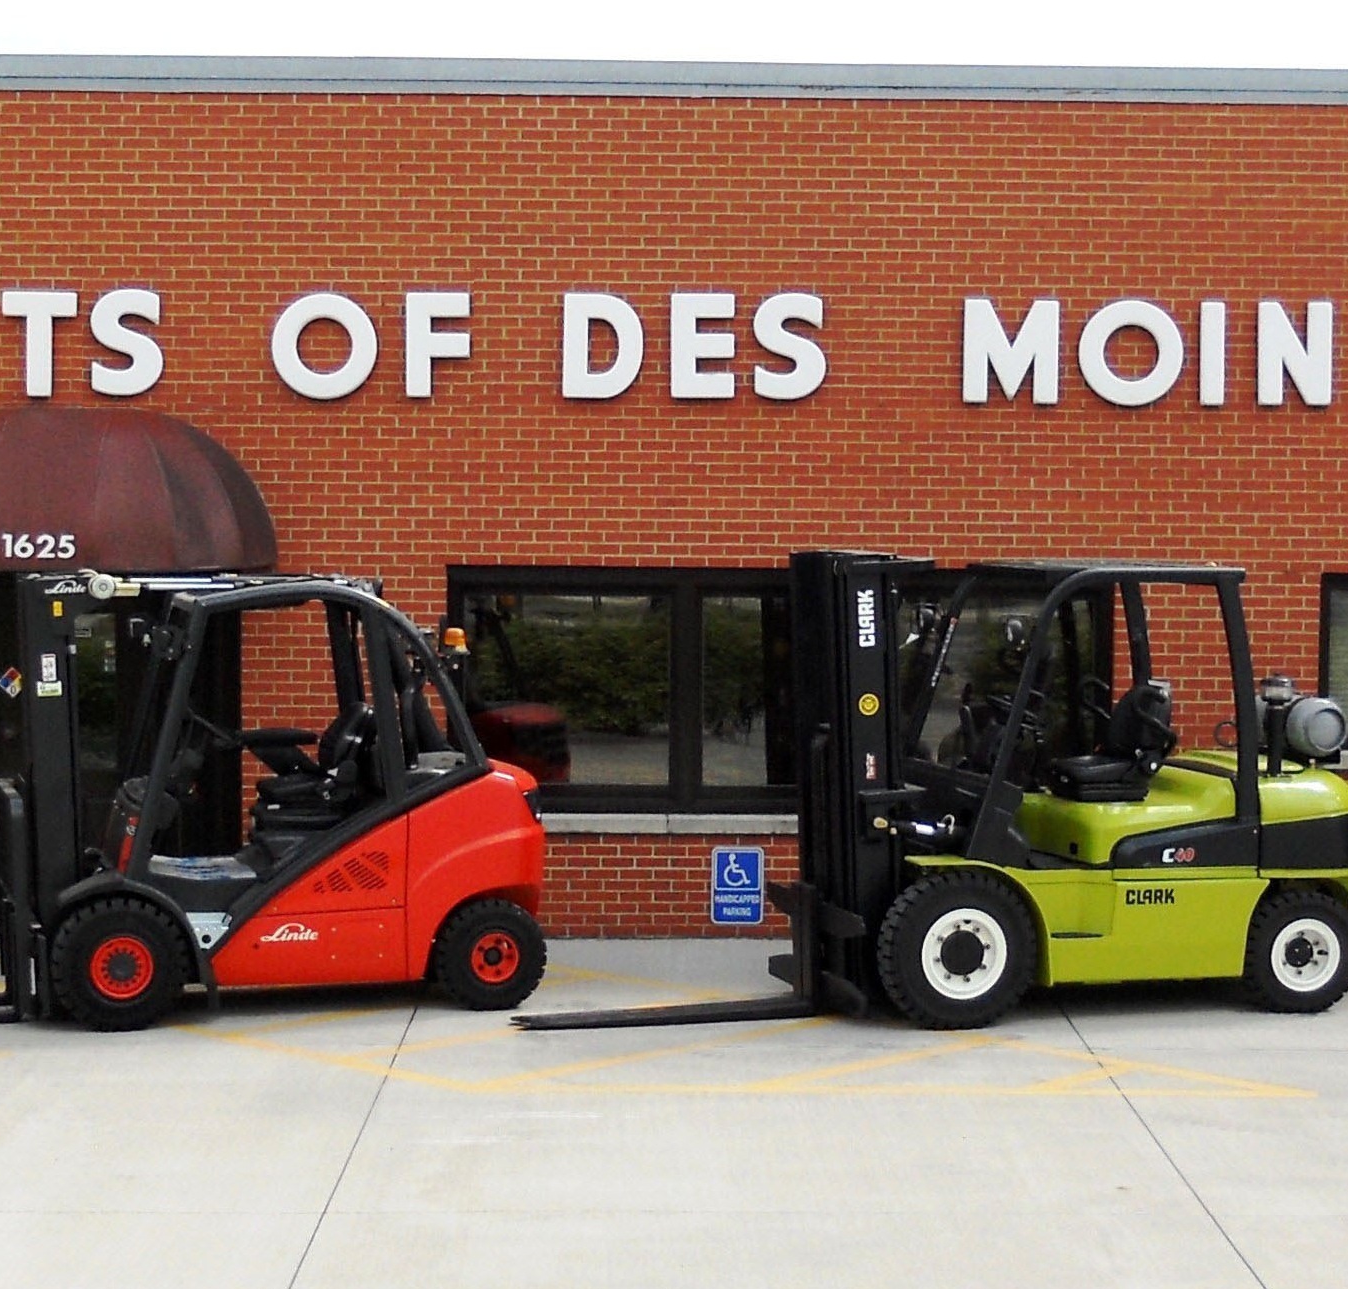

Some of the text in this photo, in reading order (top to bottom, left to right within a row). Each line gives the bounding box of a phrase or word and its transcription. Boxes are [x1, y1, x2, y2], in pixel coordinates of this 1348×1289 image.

[270, 292, 472, 400] OF
[561, 292, 829, 399] DES
[1, 533, 76, 559] 1625
[44, 579, 87, 594] Linde
[856, 588, 877, 648] CLARK
[1162, 847, 1196, 864] C40
[715, 894, 759, 904] HANDICAPPED
[1125, 888, 1175, 906] CLARK
[723, 907, 751, 916] PARKING
[260, 922, 319, 942] Linde
